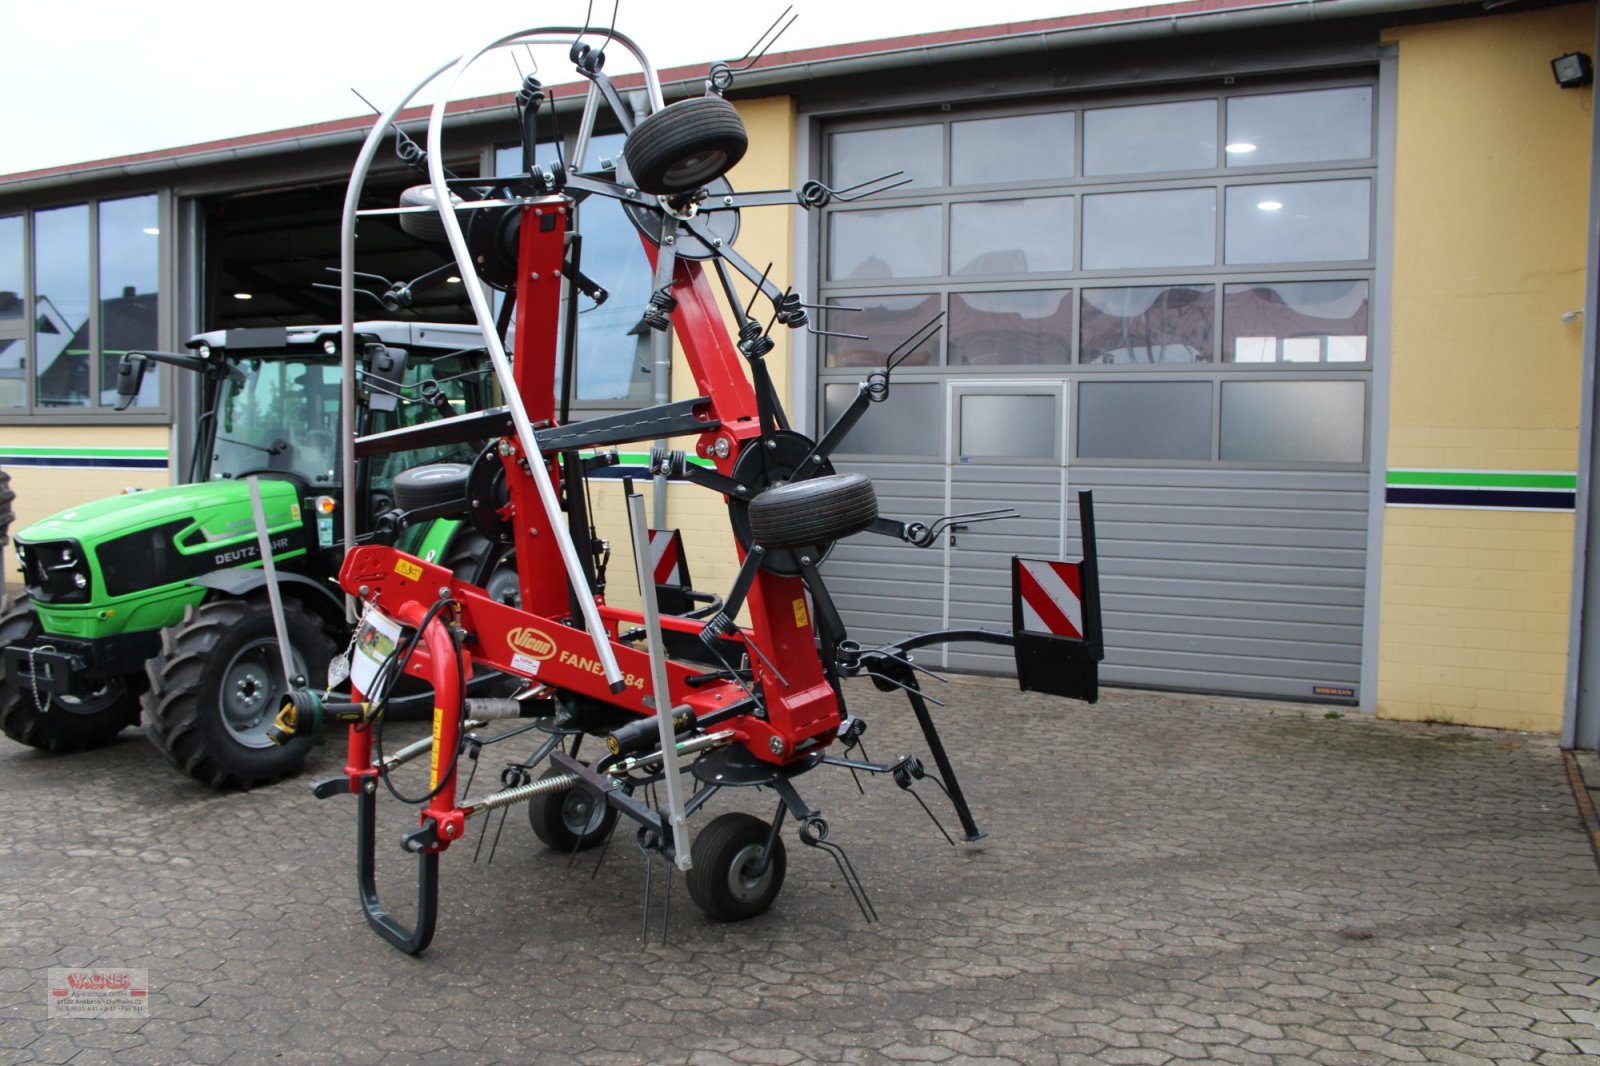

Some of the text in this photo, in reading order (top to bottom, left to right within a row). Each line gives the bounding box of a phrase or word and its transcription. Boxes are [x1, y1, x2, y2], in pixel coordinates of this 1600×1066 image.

[512, 628, 552, 655] Vicon
[559, 650, 605, 677] FANE
[620, 670, 645, 690] 84
